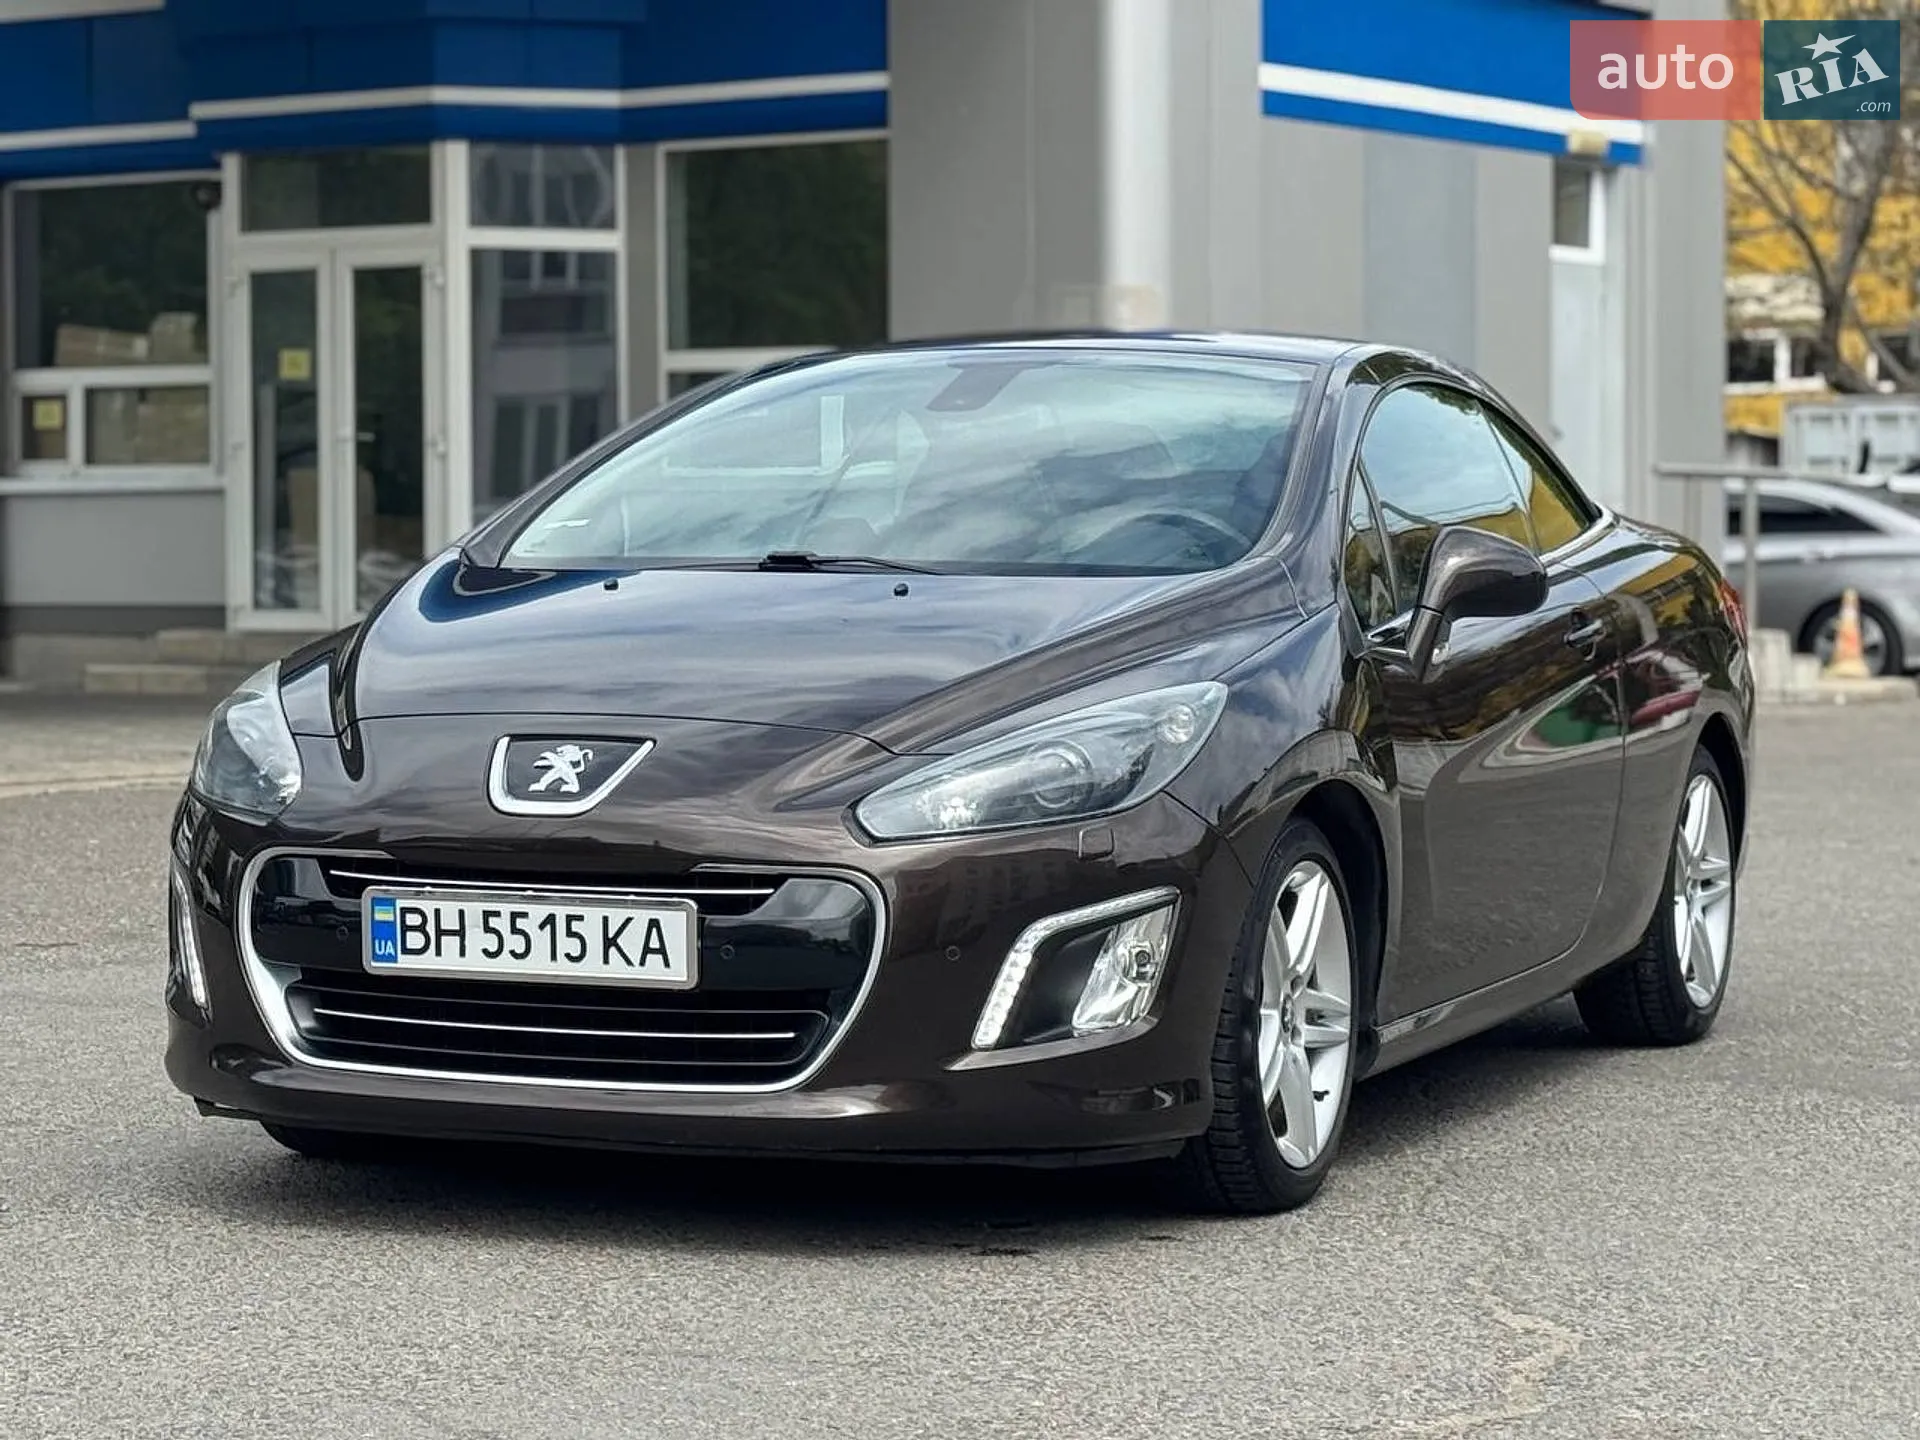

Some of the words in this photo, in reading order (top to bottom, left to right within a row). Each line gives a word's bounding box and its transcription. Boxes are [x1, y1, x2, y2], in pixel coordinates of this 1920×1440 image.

[375, 939, 395, 956] UA
[399, 906, 466, 957] BH
[481, 910, 587, 963] 5515
[602, 915, 671, 968] KA
